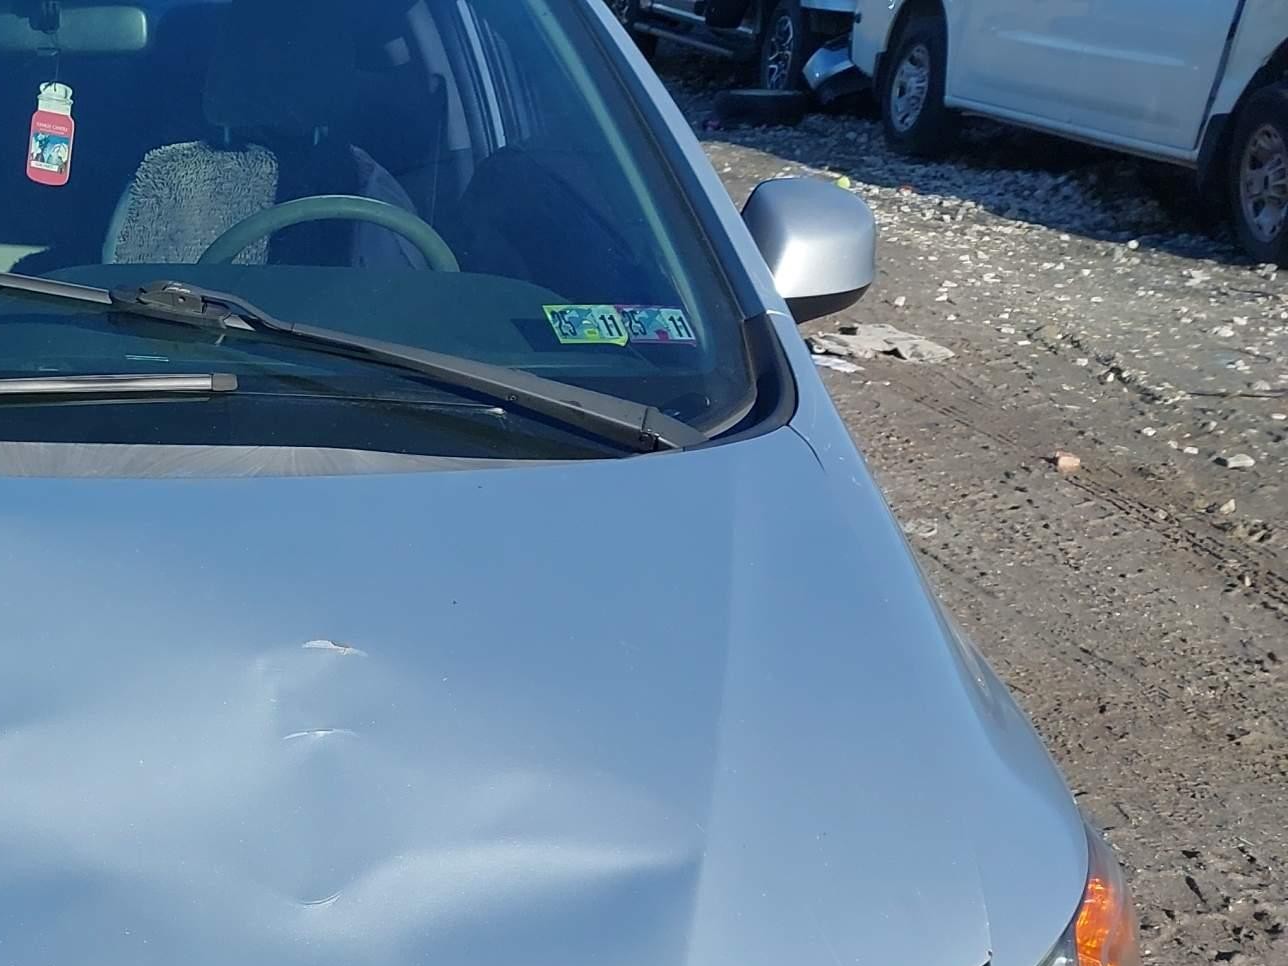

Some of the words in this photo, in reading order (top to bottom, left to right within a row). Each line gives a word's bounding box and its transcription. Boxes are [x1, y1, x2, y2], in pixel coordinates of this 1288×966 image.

[550, 310, 578, 337] 25
[598, 314, 624, 337] 11
[621, 310, 647, 336] 25
[668, 315, 692, 338] 11
